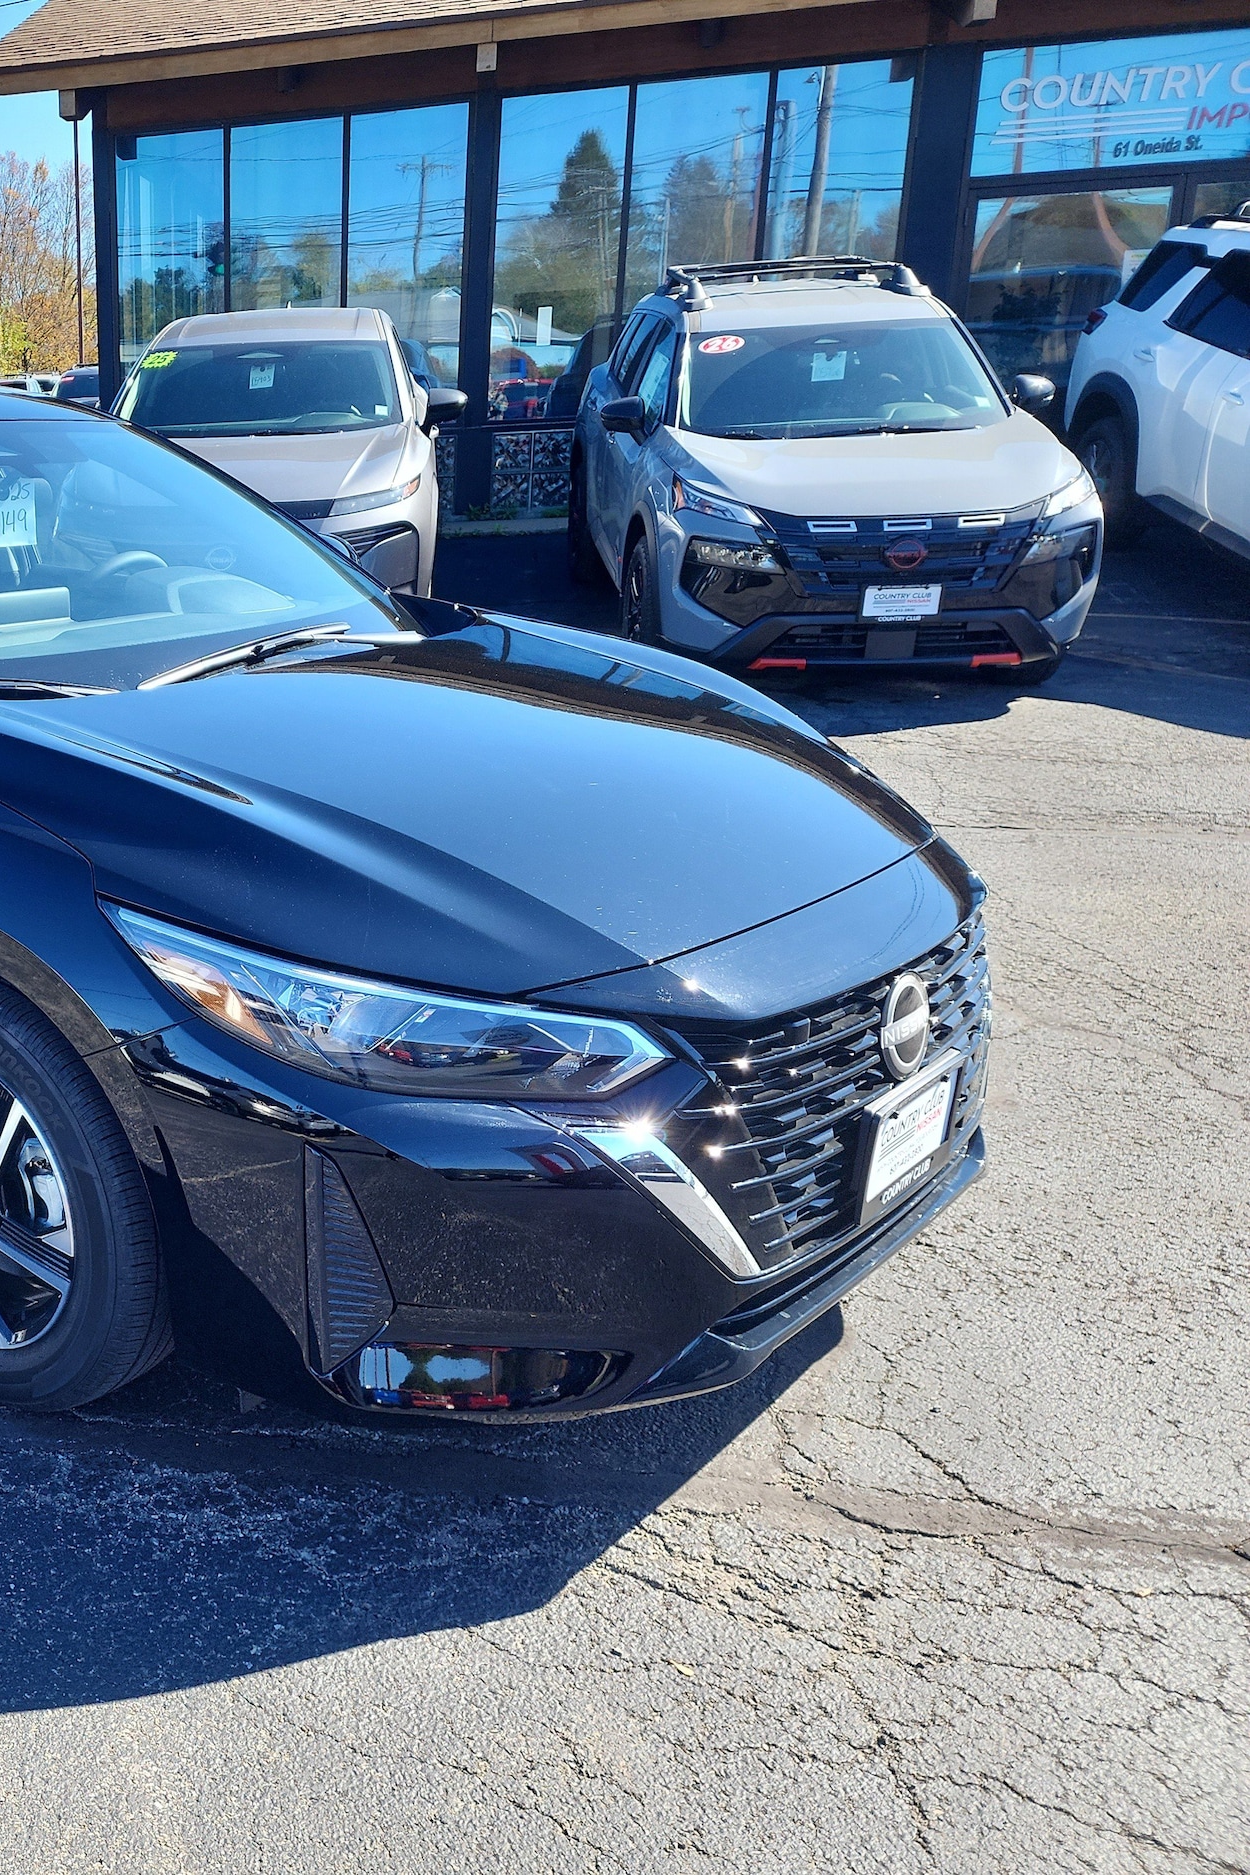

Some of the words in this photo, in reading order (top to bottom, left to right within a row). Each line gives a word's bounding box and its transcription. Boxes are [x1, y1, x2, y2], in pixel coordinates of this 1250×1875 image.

[1000, 62, 1223, 112] COUNTRY
[1113, 141, 1131, 158] 61
[1133, 137, 1182, 157] Oneida
[1184, 134, 1203, 151] St.
[704, 337, 738, 351] 26
[147, 354, 171, 366] 25
[10, 480, 31, 501] 25
[881, 1103, 925, 1147] COUNTRY
[924, 1089, 946, 1117] CLUB
[916, 1107, 943, 1132] NISSAN
[881, 1171, 915, 1205] COUNTRY
[913, 1158, 931, 1181] CLUB
